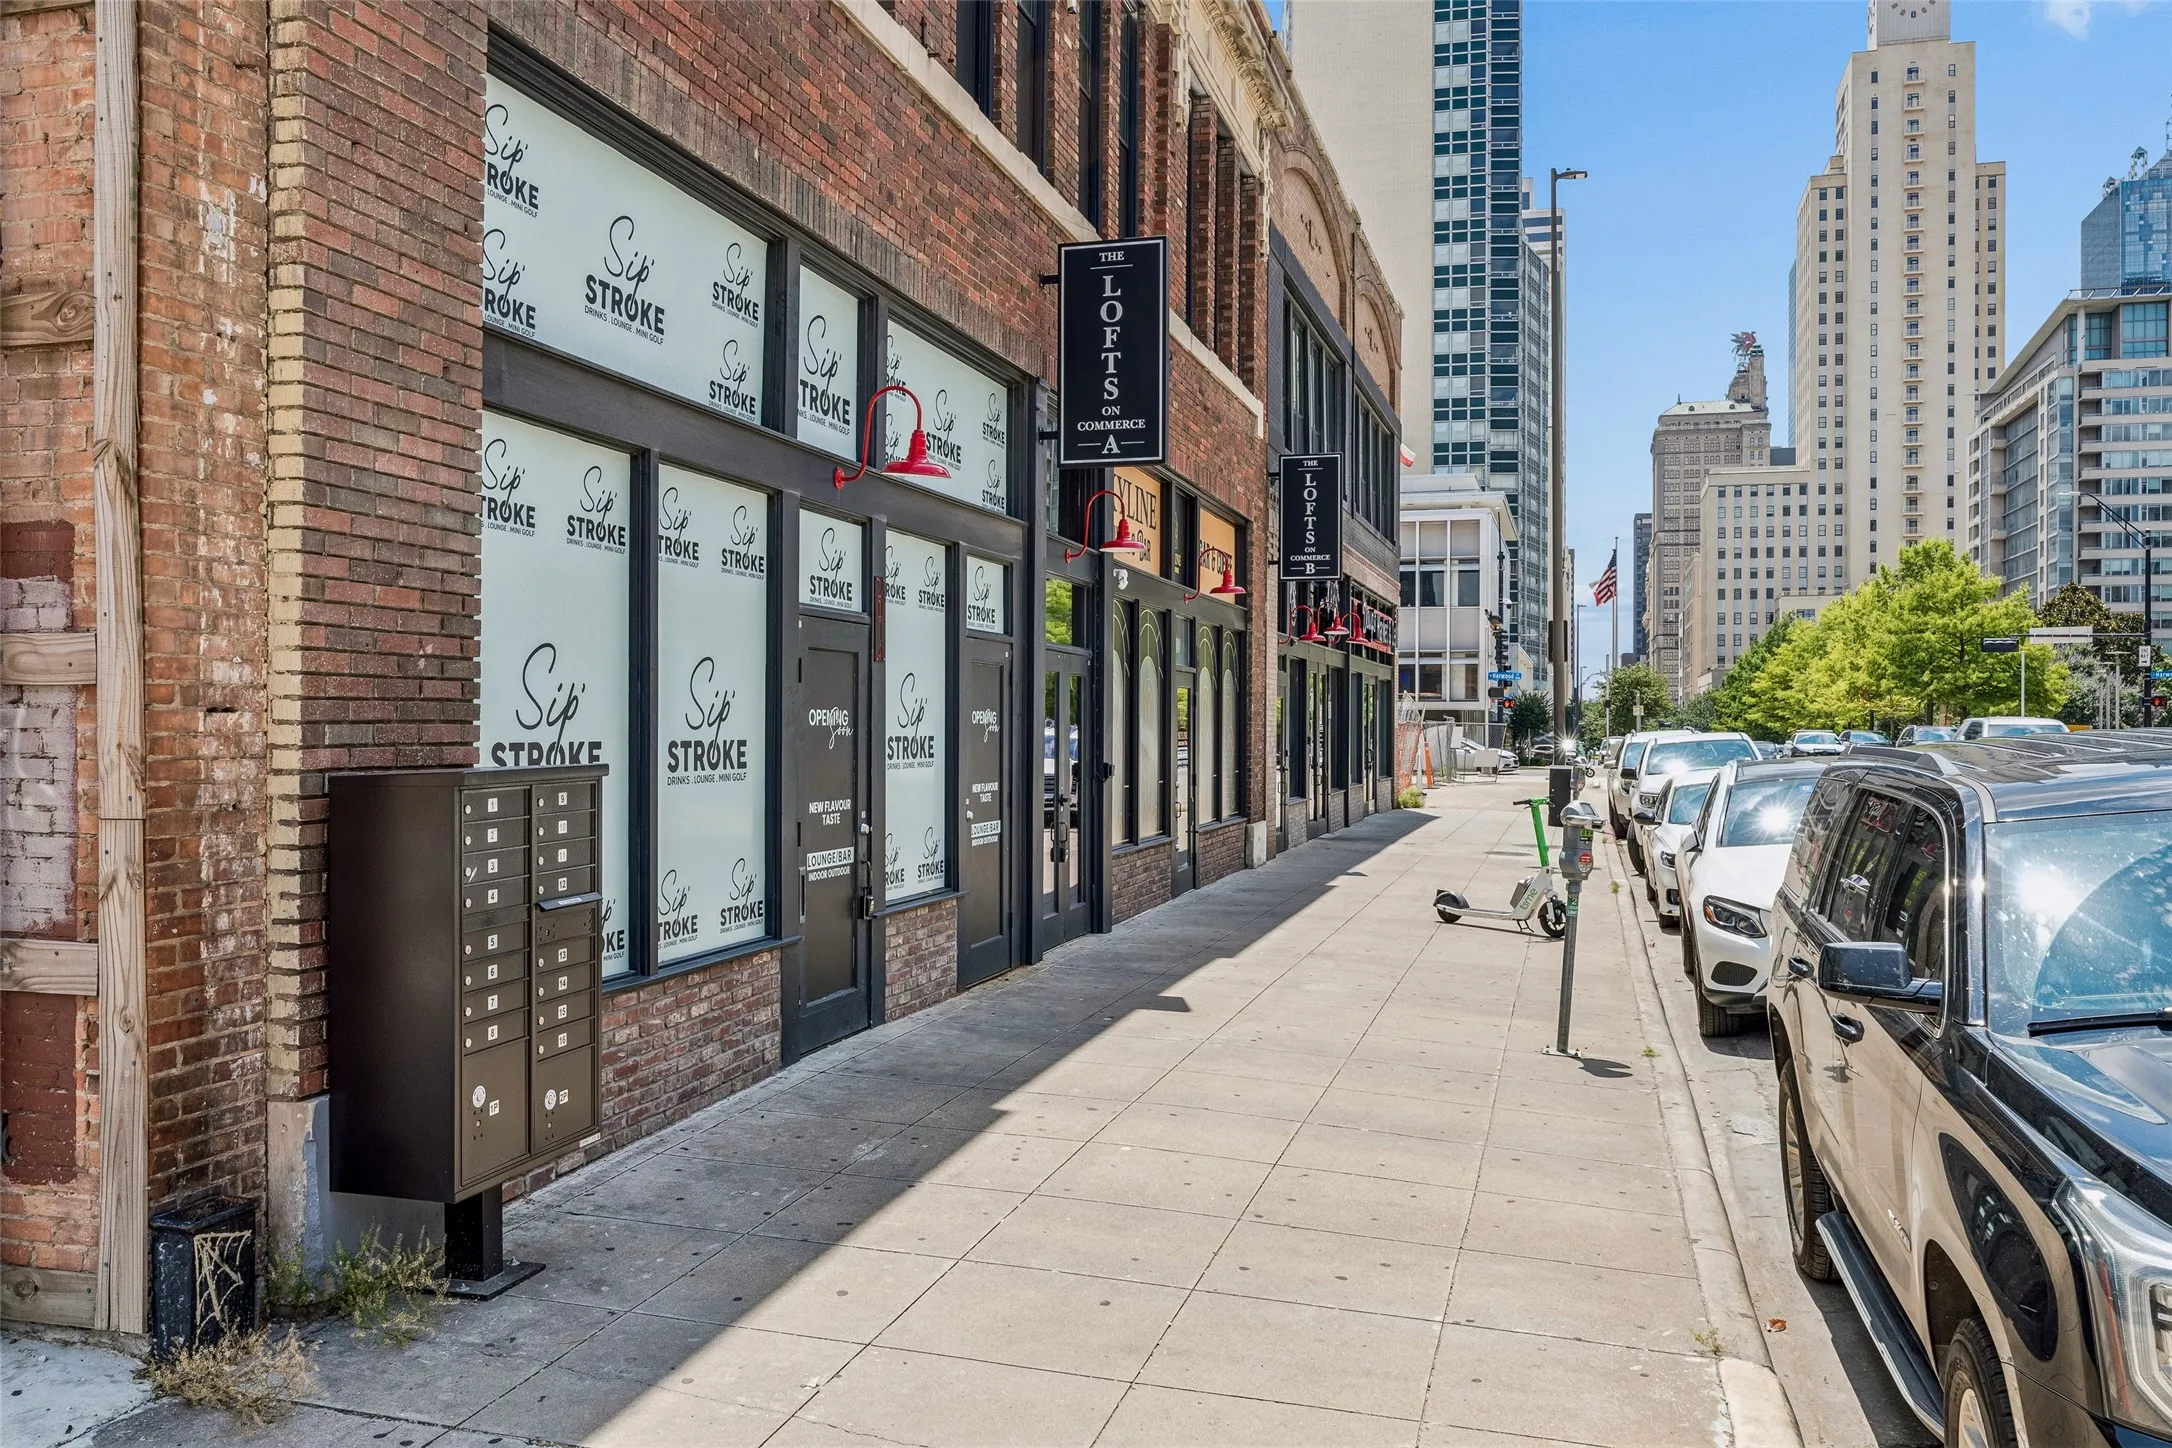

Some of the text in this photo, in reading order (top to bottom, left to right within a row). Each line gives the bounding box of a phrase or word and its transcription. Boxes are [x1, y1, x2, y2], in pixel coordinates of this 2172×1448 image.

[484, 160, 539, 210] ROKE
[487, 188, 538, 218] LOUNGE MINI GOLF
[1099, 251, 1124, 262] THE
[484, 287, 536, 329] ROKE
[585, 274, 665, 336] STROKE
[713, 281, 759, 321] STROKE
[485, 314, 535, 338] LOUNGE MINI GOLF
[584, 305, 664, 345] DRINKS LOUNGE MINI GOLF
[1100, 275, 1123, 400] LOFTS
[709, 380, 756, 415] STROKE
[798, 379, 850, 426] TROKE
[1102, 406, 1120, 416] ON
[810, 413, 826, 427] LOUNGE
[829, 421, 839, 432] MINI
[839, 425, 850, 435] GOLF
[1077, 419, 1146, 431] COMMERCE
[982, 422, 1005, 444] STROKE
[926, 432, 961, 464] STROKE
[1102, 434, 1121, 454] A
[982, 490, 1004, 510] STROKE
[1114, 474, 1156, 530] YLINE
[478, 495, 535, 528] TROKE
[1303, 474, 1317, 544] LOFTS
[488, 521, 507, 532] LOUNGE
[510, 527, 520, 535] MINI
[522, 529, 535, 537] GOLF
[567, 515, 626, 546] STROKE
[567, 538, 583, 546] DRINKS
[586, 542, 602, 550] LOUNGE
[657, 534, 699, 561] TROKE
[721, 548, 764, 573] STROKE
[1305, 563, 1316, 574] B
[810, 575, 852, 601] STROKE
[885, 583, 905, 600] ROKE
[919, 590, 944, 607] STROKE
[968, 604, 995, 624] STROKE
[809, 709, 848, 726] OPENING
[972, 710, 996, 724] OPENING
[667, 739, 747, 773] STROKE
[887, 735, 934, 760] STROKE
[667, 772, 746, 786] DRINKS LOUNGE MINI GOLF
[972, 782, 998, 793] NEW FLAVOUR
[980, 793, 991, 802] TASTE
[809, 799, 851, 814] NEW FLAVOUR
[559, 823, 566, 831] 10
[822, 813, 840, 825] TASTE
[559, 852, 566, 860] 11
[808, 850, 852, 867] LOUNGE/BAR
[809, 866, 850, 881] INDOOR OUTDOOR
[885, 868, 904, 885] ROKE
[918, 860, 943, 878] STROKE
[559, 880, 566, 888] 12
[720, 900, 763, 926] STROKE
[559, 951, 566, 959] 13
[559, 979, 566, 987] 14
[559, 1008, 566, 1016] 15
[559, 1036, 566, 1044] 16
[560, 1092, 567, 1101] 2P
[490, 1103, 498, 1113] 1P
